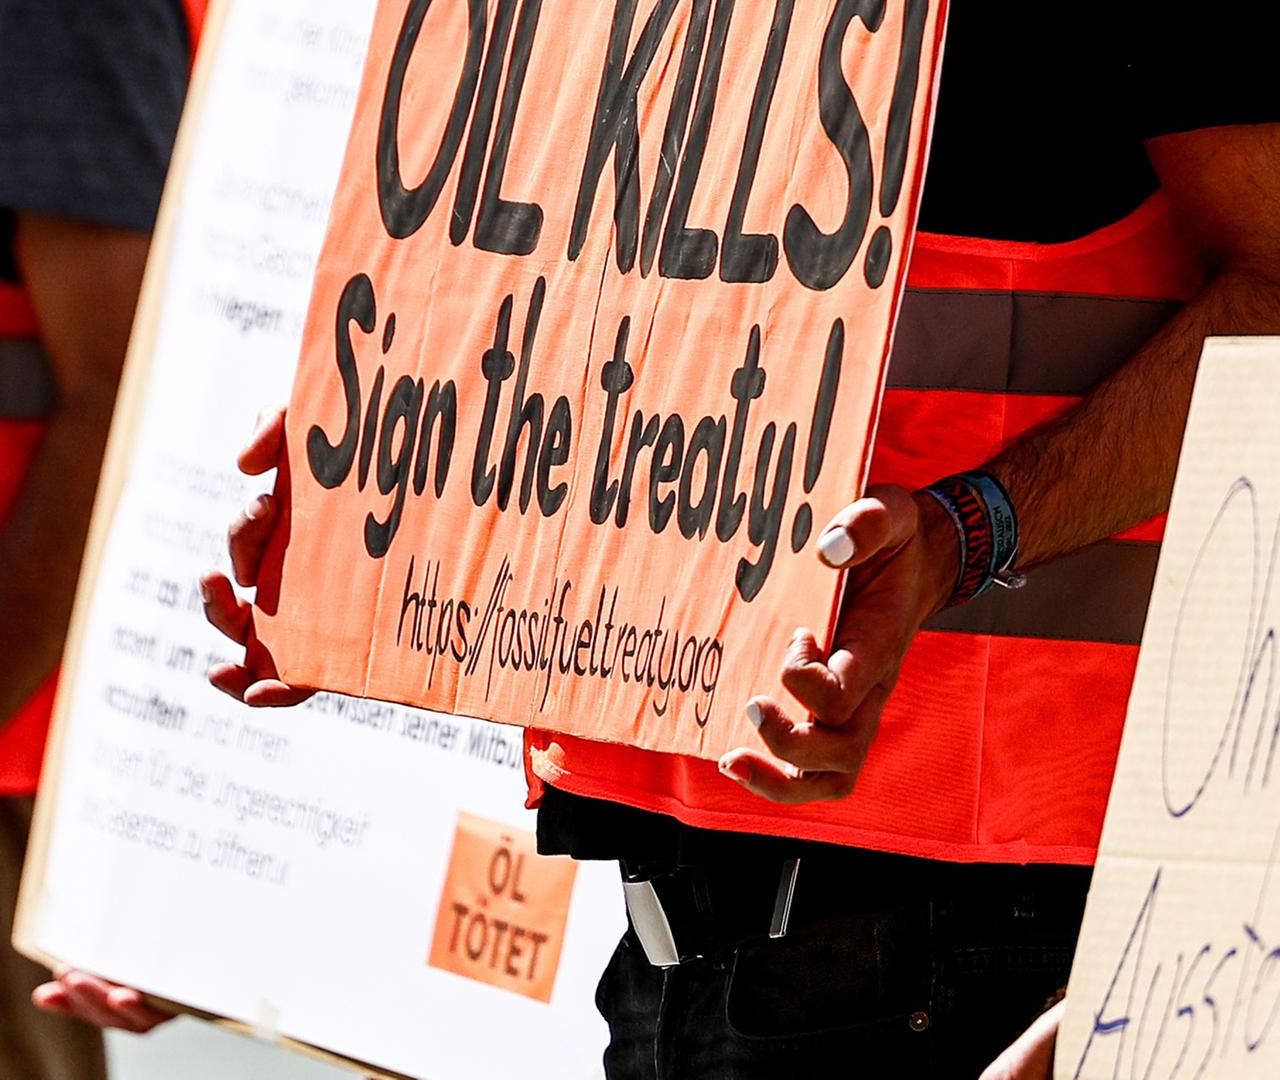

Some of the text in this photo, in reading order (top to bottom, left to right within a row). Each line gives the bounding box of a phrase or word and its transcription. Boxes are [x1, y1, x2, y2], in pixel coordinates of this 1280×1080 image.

[307, 273, 457, 558] Sign
[470, 275, 571, 517] the
[589, 316, 844, 602] treaty!
[396, 554, 723, 728] https://fossilfueltreaty.org
[487, 834, 525, 903] ÖL
[449, 893, 549, 982] TÖTET
